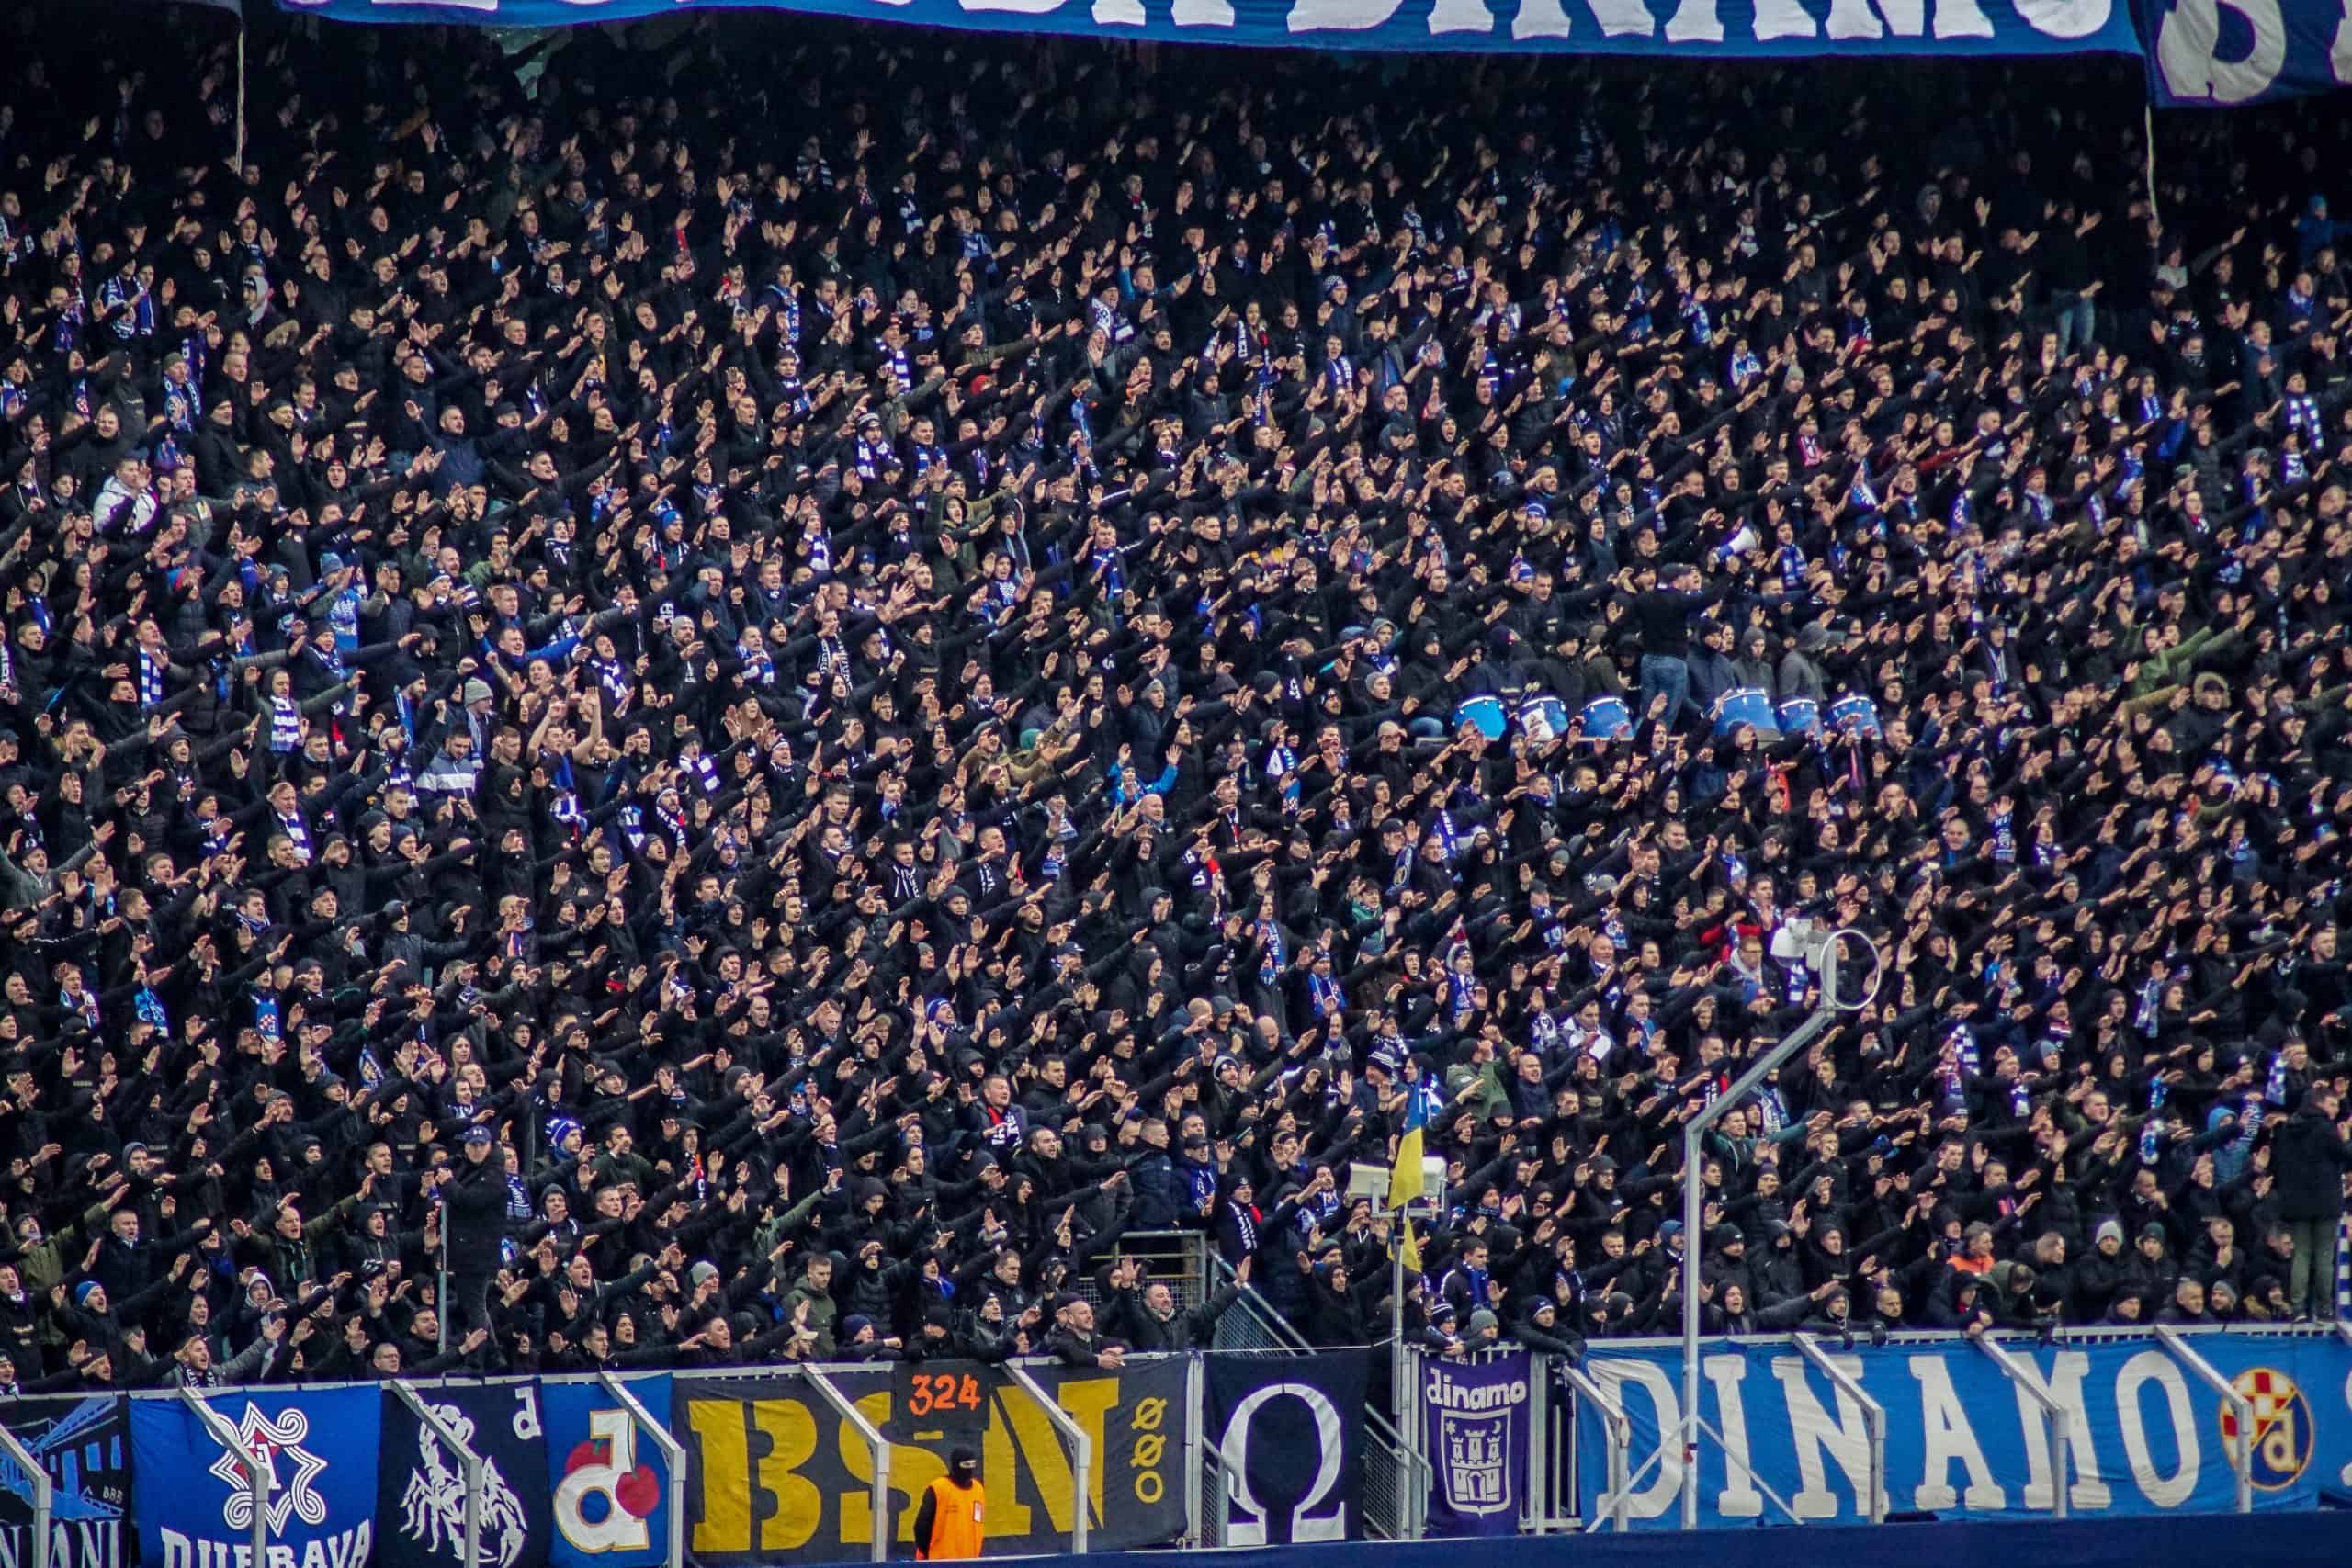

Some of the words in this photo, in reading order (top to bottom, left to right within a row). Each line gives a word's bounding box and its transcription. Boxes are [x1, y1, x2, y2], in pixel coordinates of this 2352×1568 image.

[909, 1373, 981, 1416] 324
[1427, 1367, 1526, 1410] dinamo
[513, 1386, 542, 1440] d
[1585, 1350, 2200, 1519] DINAMO
